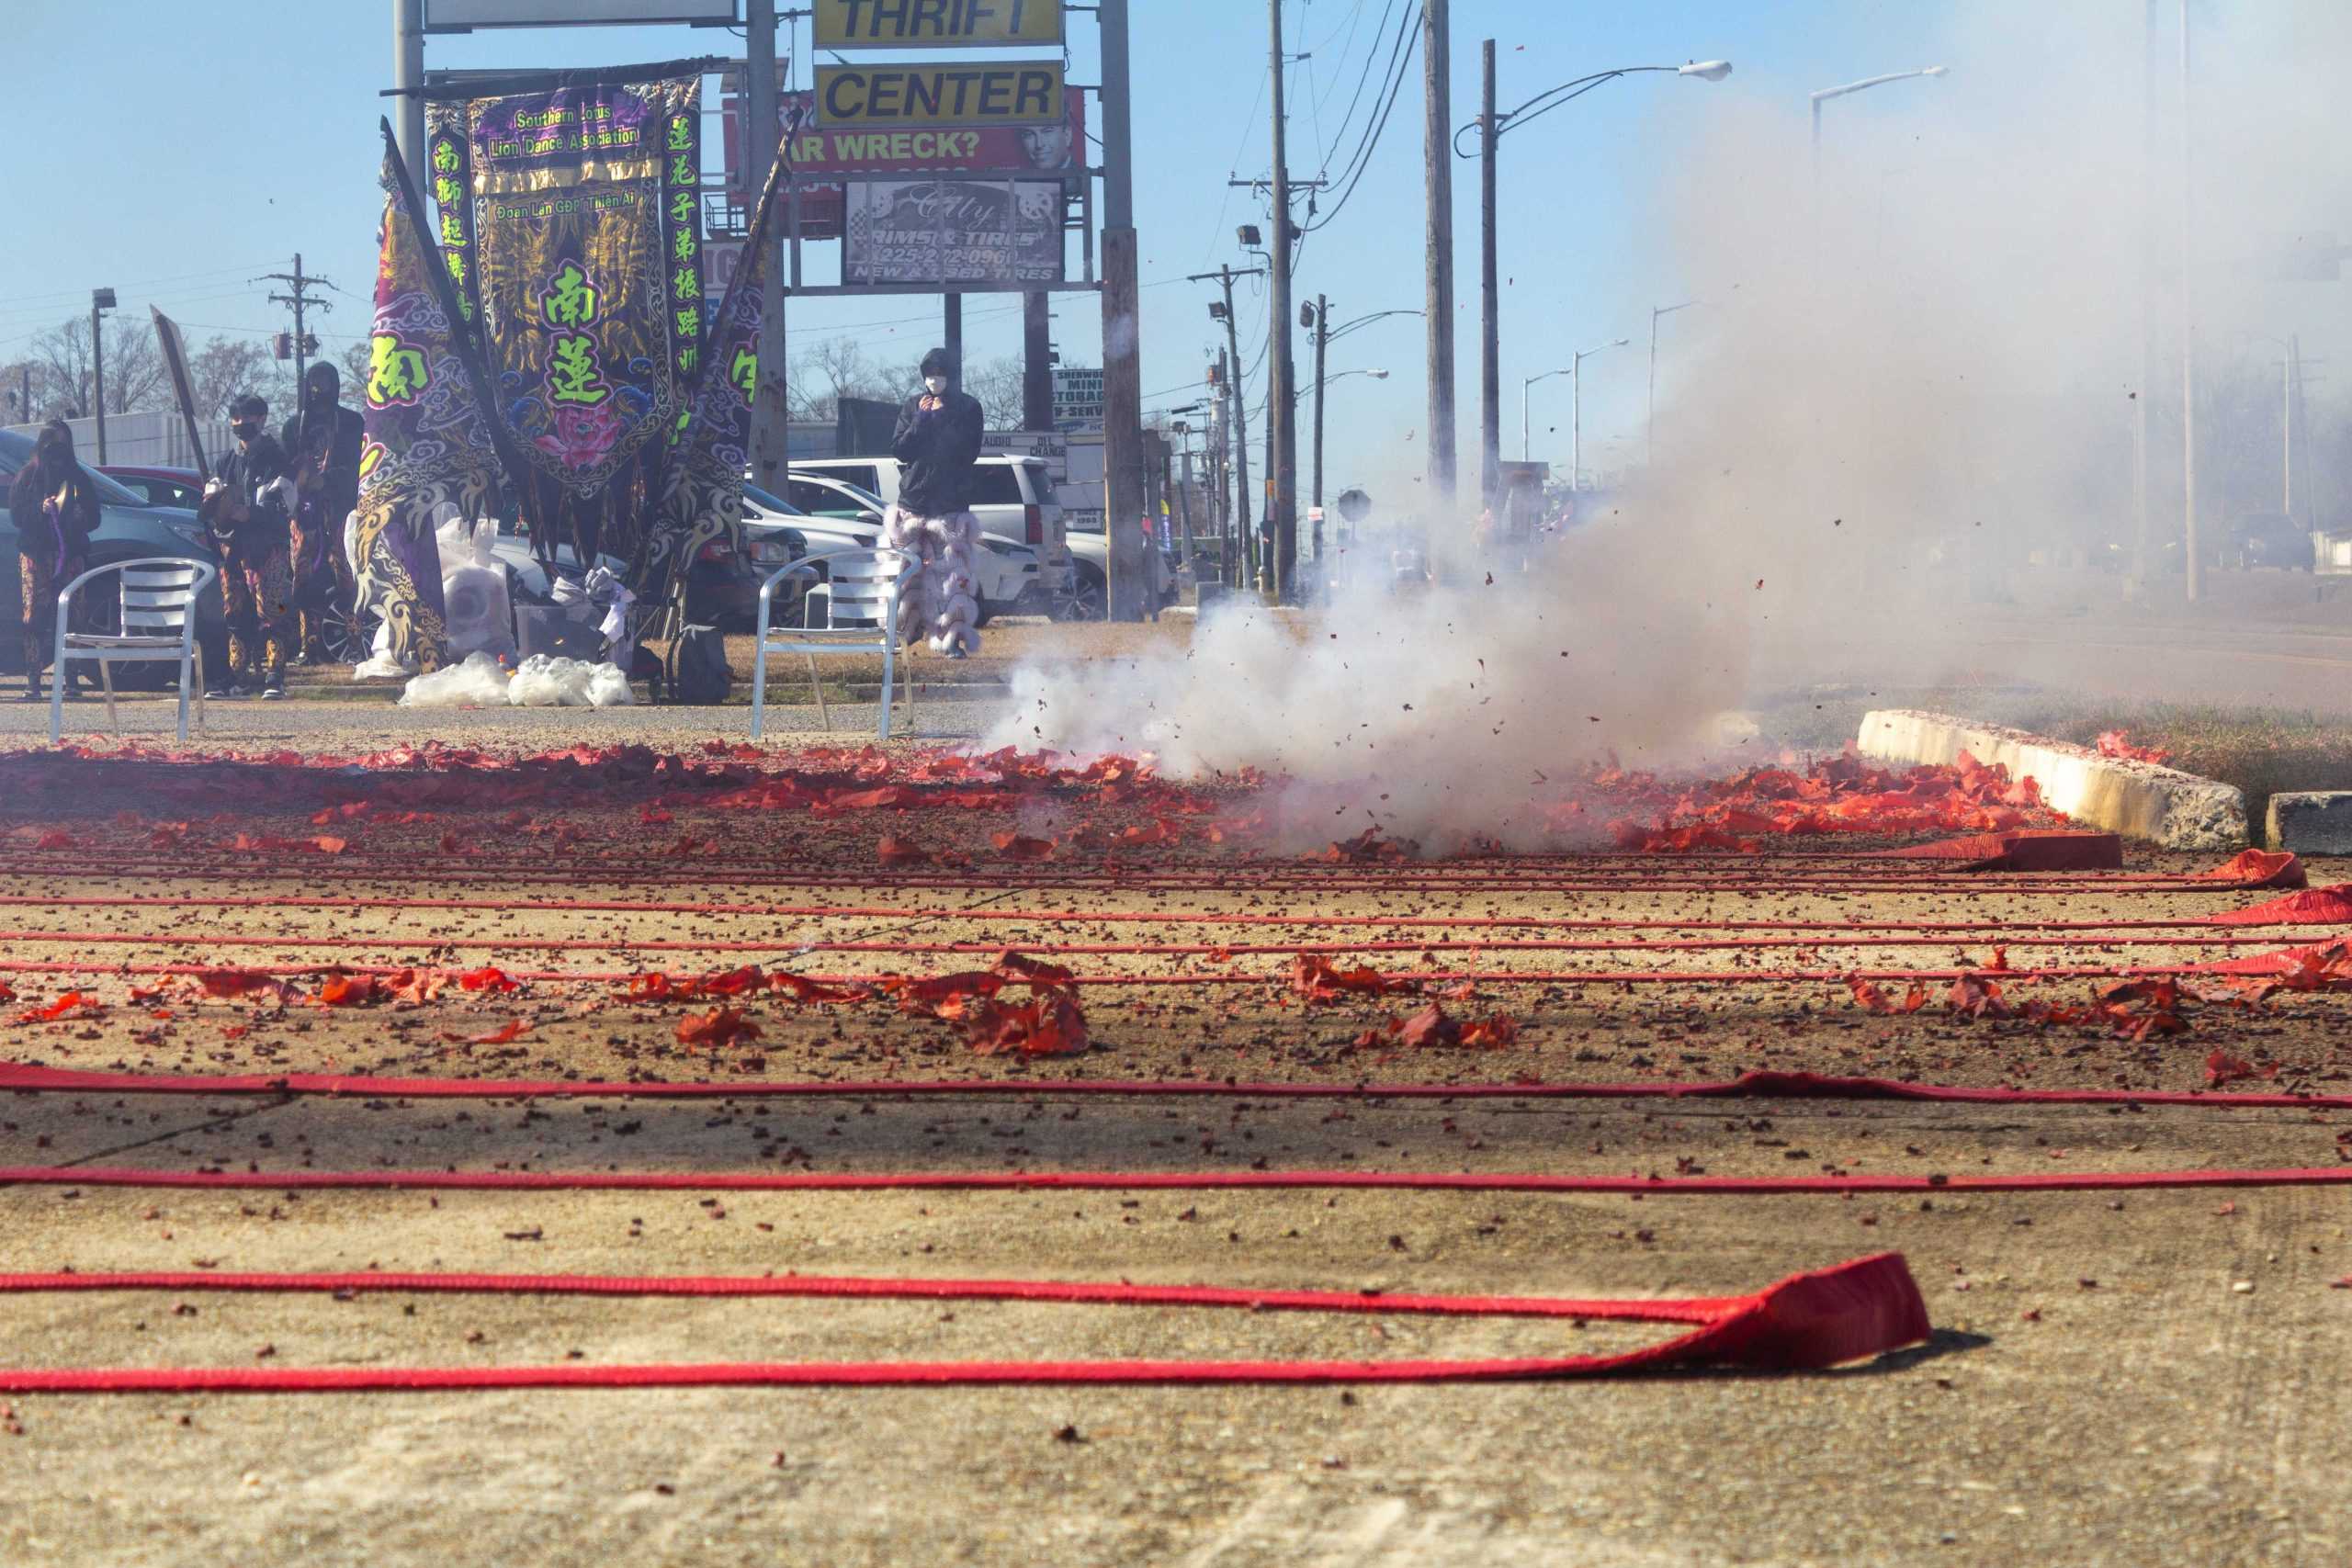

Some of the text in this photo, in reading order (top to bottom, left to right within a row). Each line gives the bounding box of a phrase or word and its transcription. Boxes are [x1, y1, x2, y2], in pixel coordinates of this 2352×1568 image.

[837, 0, 1024, 37] THRIFT
[827, 71, 1053, 118] CENTER
[516, 109, 574, 129] Southern
[491, 130, 638, 157] Lion Dance Association
[833, 132, 980, 161] WRECK?
[873, 231, 933, 245] RIMS
[965, 232, 1037, 246] TIRES
[854, 266, 902, 277] NEW
[994, 267, 1054, 279] TIRES
[546, 266, 606, 402] 南蓮
[1068, 379, 1102, 389] MINI
[1036, 435, 1054, 446] OIL
[1029, 446, 1067, 457] CHANGE
